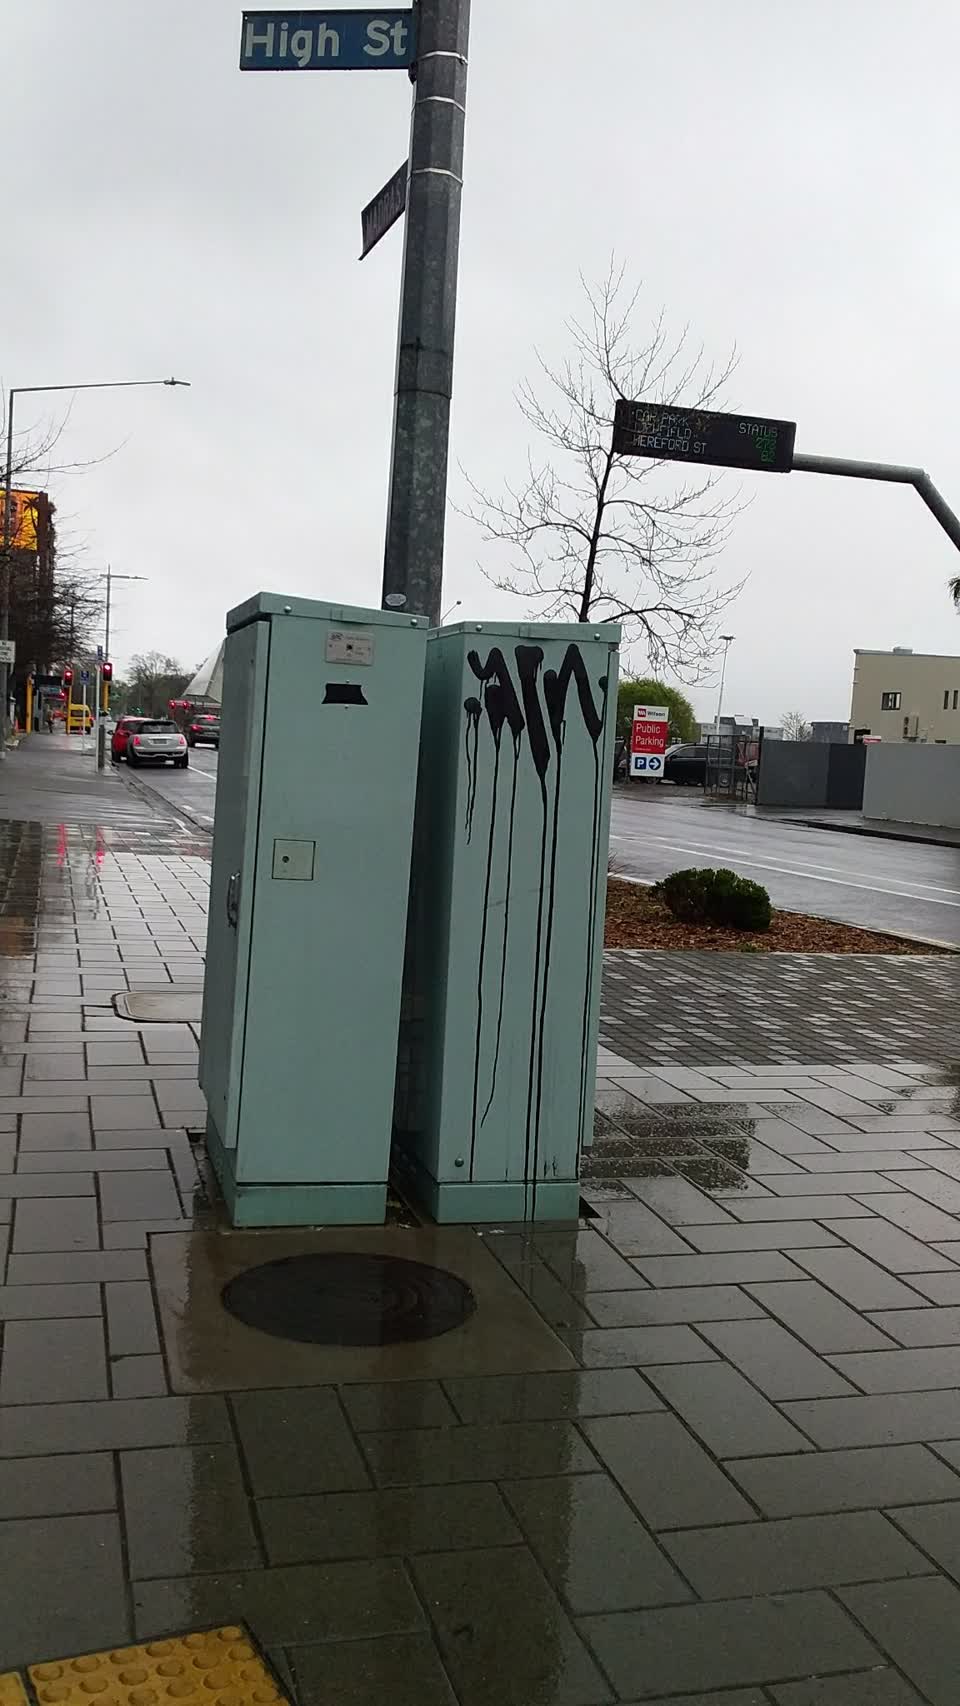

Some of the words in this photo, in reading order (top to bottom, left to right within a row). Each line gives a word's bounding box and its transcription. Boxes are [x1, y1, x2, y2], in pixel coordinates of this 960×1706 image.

[244, 22, 339, 67] High
[363, 20, 408, 56] St
[661, 412, 690, 427] PARK
[738, 422, 778, 437] STATUS
[633, 434, 690, 452] HEREFORD
[693, 441, 707, 454] ST
[636, 723, 661, 734] Public
[635, 735, 664, 747] Parking
